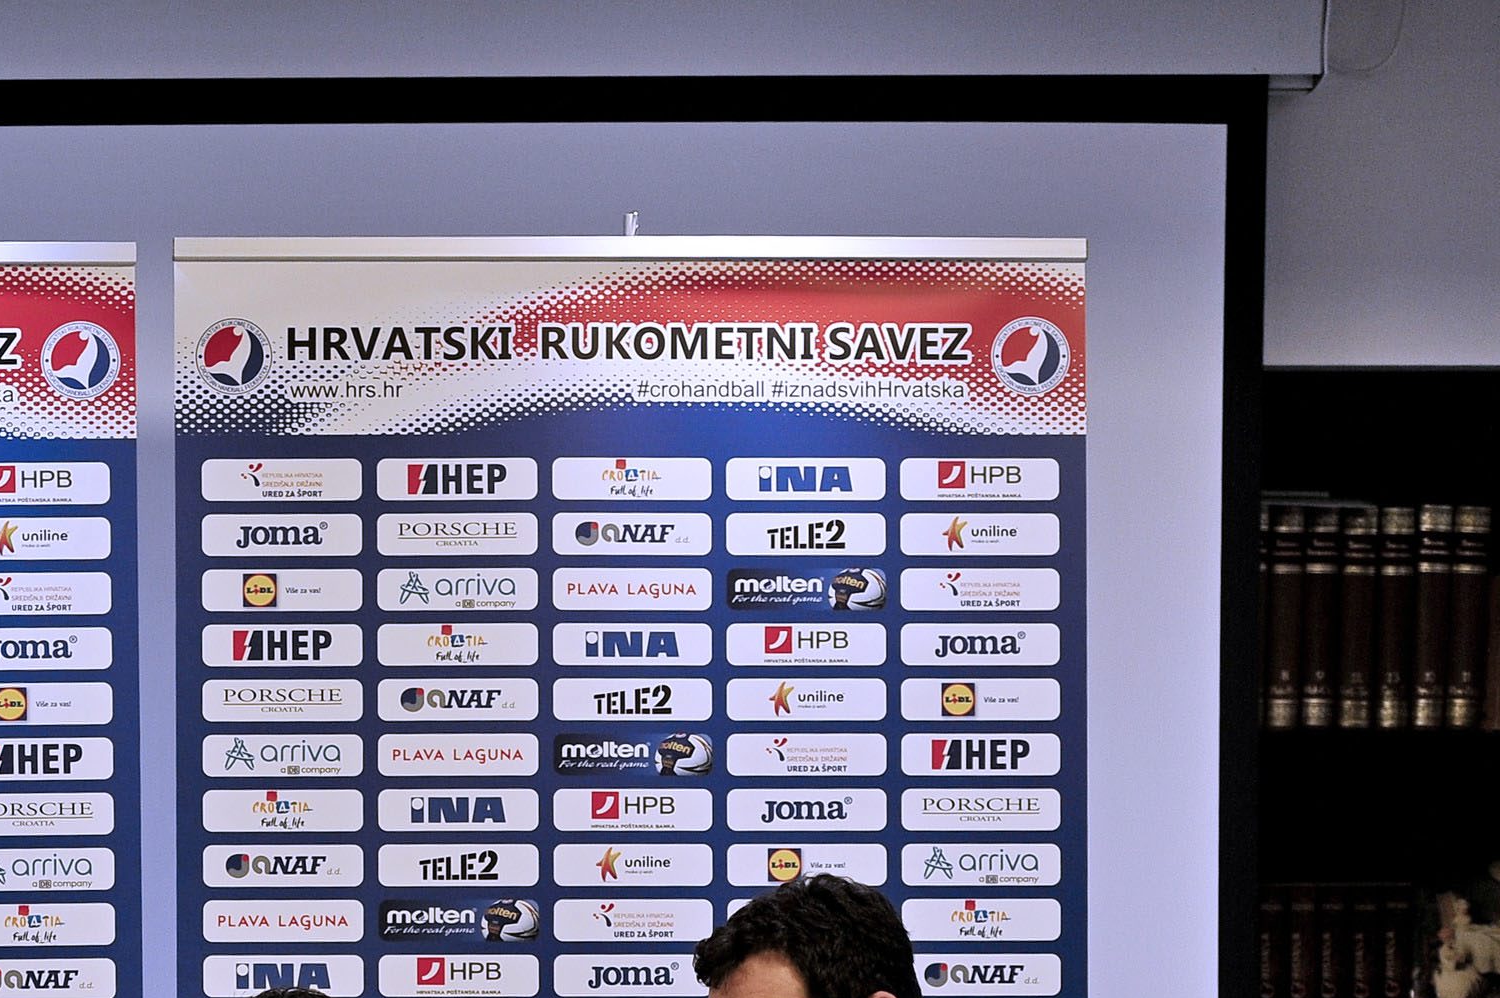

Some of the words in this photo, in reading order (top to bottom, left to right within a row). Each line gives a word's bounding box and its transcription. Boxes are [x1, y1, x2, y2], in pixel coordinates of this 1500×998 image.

[287, 326, 510, 361] HRVATSKI
[540, 325, 813, 361] RUKOMETNI
[828, 327, 969, 360] SAVEZ
[290, 382, 403, 398] www.hrs.hr
[637, 380, 764, 399] #crohandball
[771, 379, 965, 399] #iznadsvihHrvatska
[20, 469, 72, 487] HPB
[443, 465, 506, 493] HEP
[20, 529, 66, 541] uniline
[435, 573, 516, 596] arriva
[797, 630, 848, 648] HPB
[224, 689, 342, 703] PORSCHE
[593, 684, 672, 714] TELE2
[796, 690, 842, 702] uniline
[561, 739, 648, 758] molten
[822, 763, 848, 772] ŠPORT
[218, 915, 270, 928] PLAVA
[278, 914, 348, 930] LAGUNA
